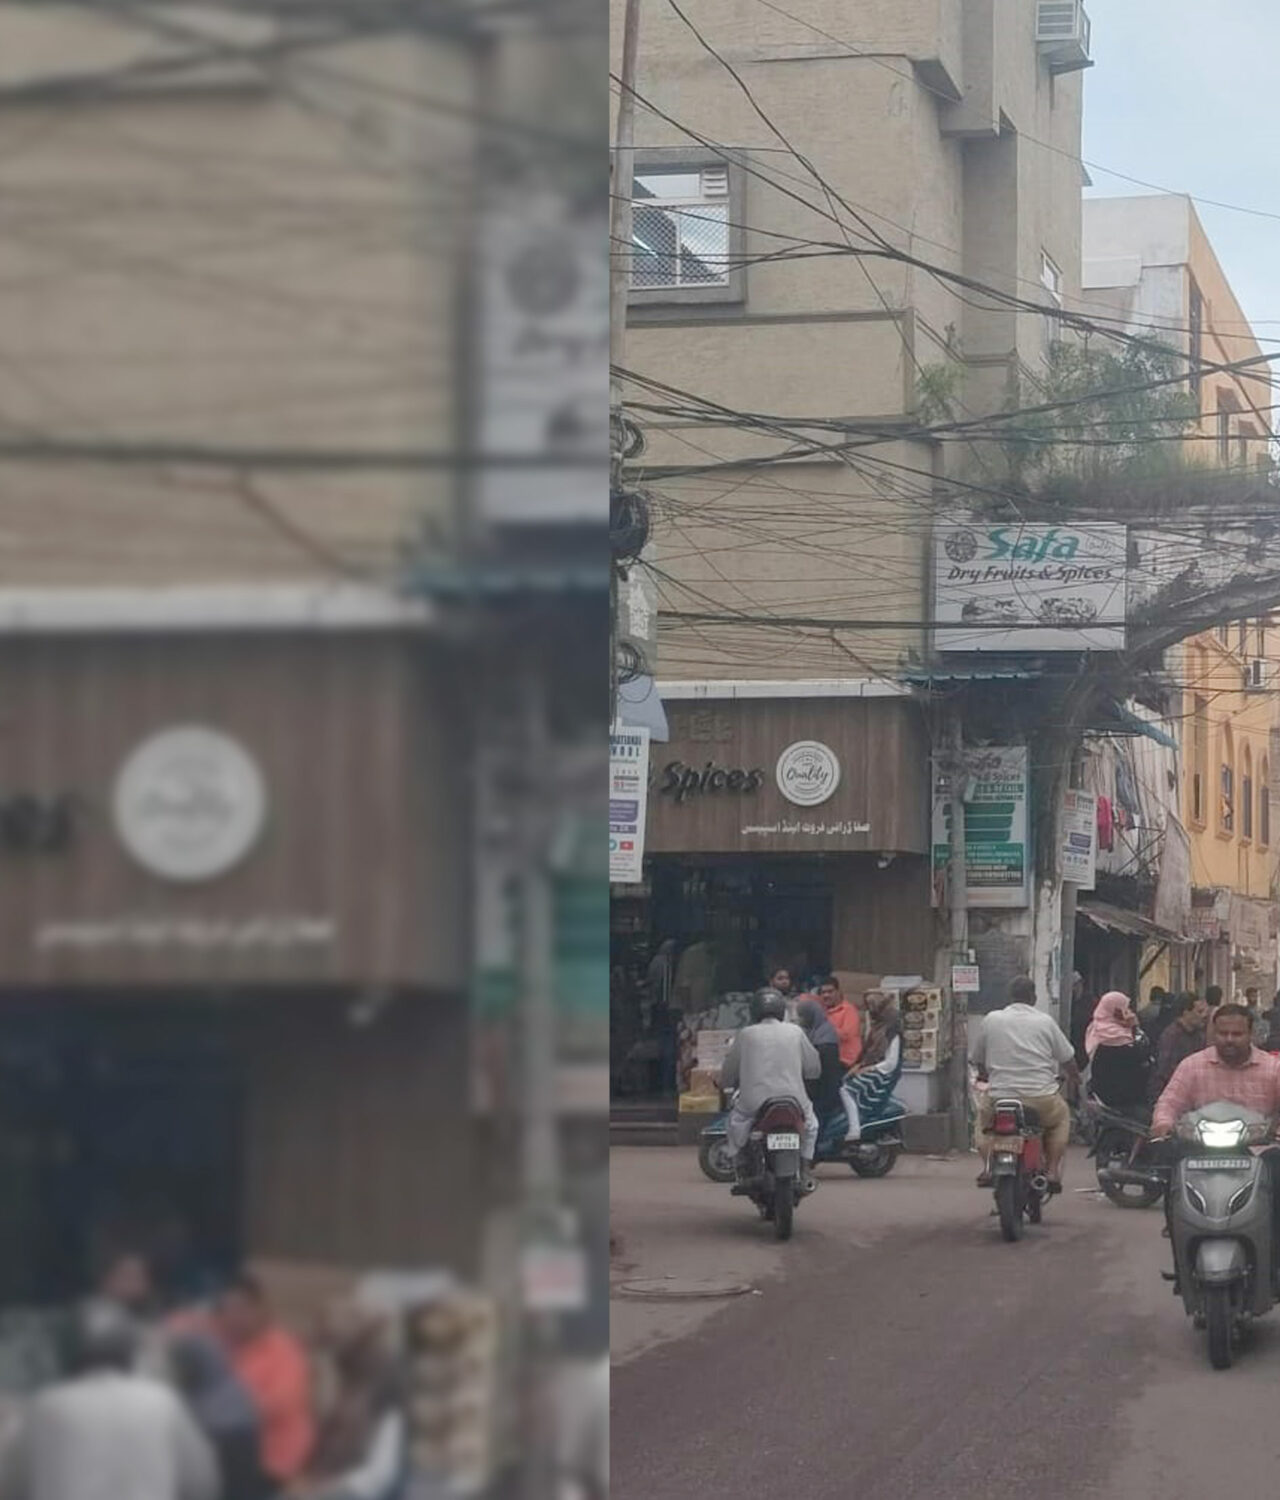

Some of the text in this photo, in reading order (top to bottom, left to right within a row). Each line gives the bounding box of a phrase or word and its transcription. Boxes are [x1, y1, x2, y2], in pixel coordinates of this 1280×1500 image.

[985, 528, 1079, 563] Safa
[948, 565, 979, 583] Dry
[984, 565, 1036, 580] Fruits
[1057, 566, 1112, 583] Spices
[660, 761, 765, 800] Spices
[785, 764, 829, 784] Quality
